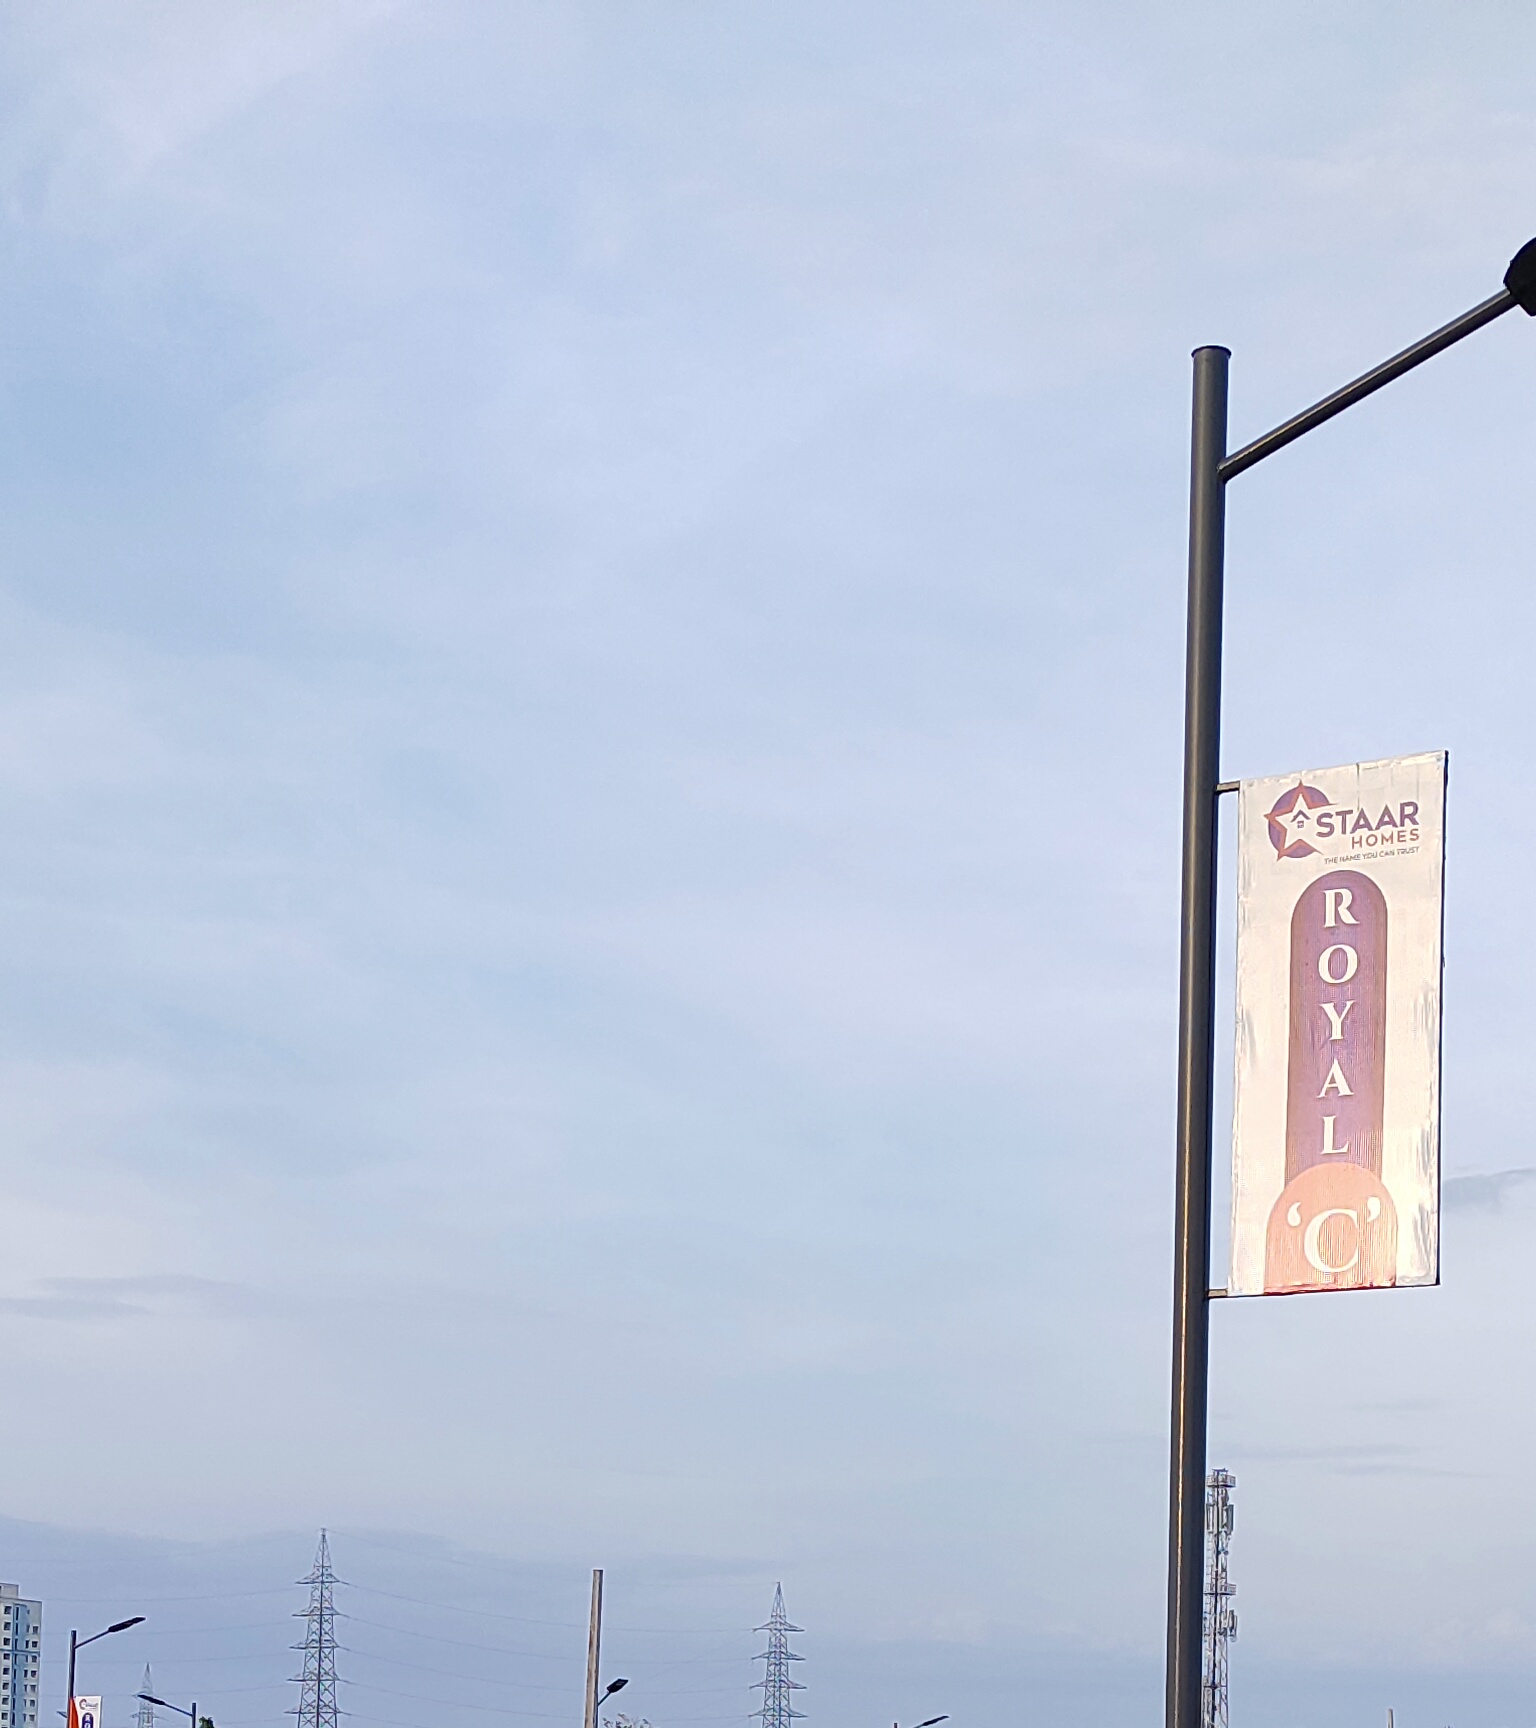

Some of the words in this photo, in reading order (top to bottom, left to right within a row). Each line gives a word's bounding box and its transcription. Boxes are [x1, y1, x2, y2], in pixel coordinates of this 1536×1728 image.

[1315, 801, 1420, 838] STAAR
[1351, 828, 1420, 849] HOMES
[1340, 854, 1361, 863] NAME
[1362, 851, 1377, 860] YOU
[1380, 849, 1395, 858] CAN
[1397, 846, 1420, 856] TRUST
[1317, 888, 1360, 1156] ROYAL
